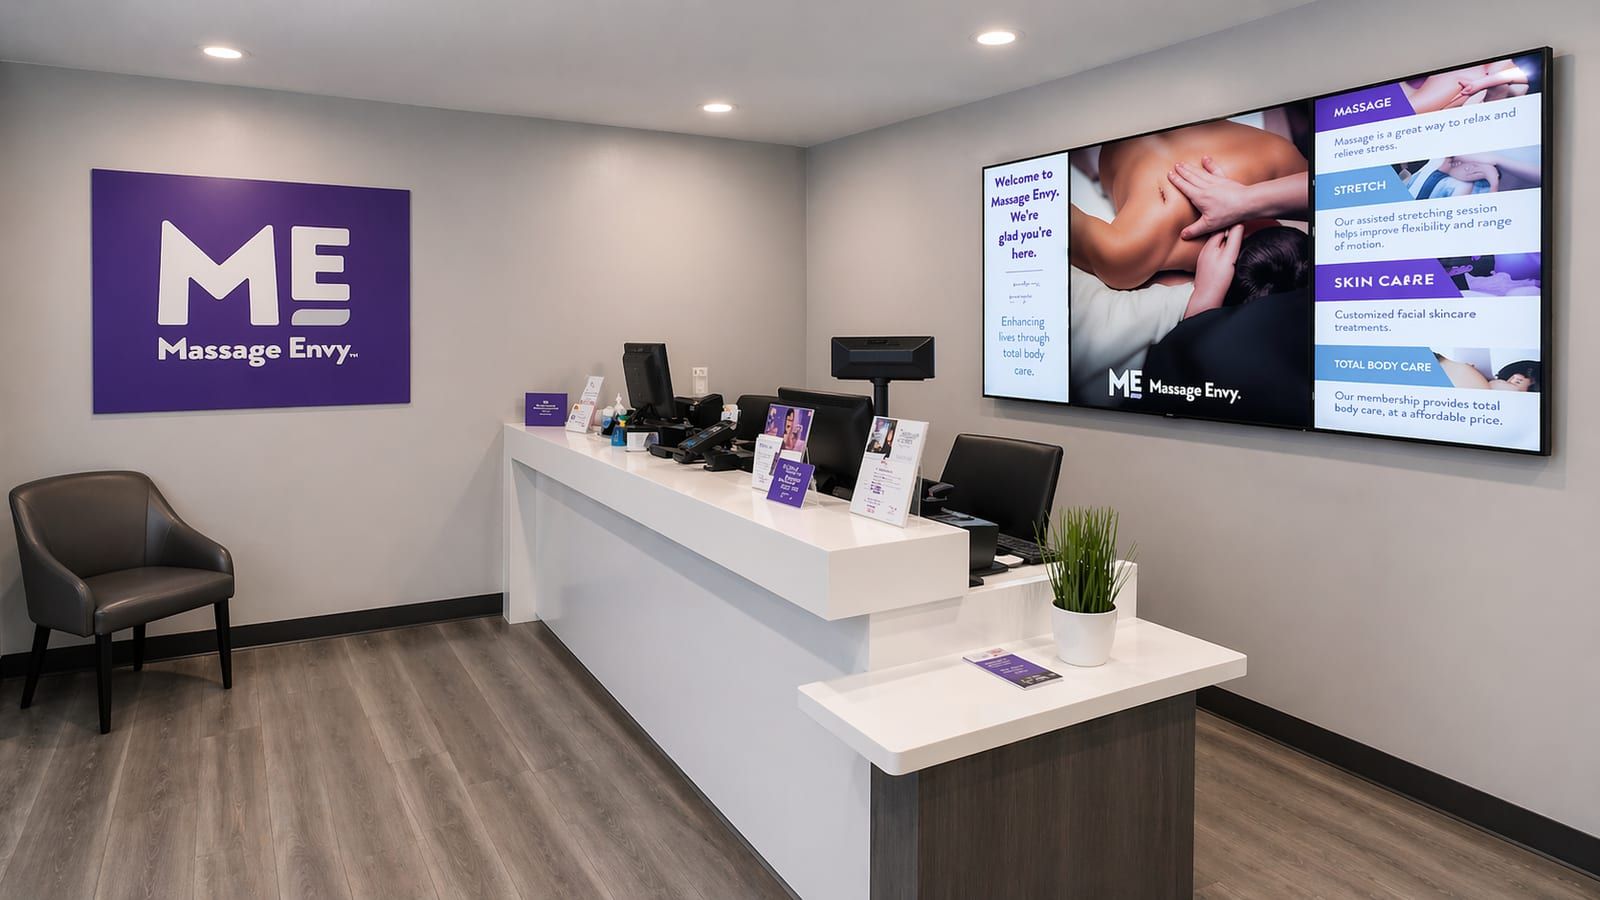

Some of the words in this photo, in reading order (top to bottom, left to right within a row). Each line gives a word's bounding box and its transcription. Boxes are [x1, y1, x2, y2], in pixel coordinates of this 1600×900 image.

[1334, 98, 1391, 117] MASSAGE
[1334, 133, 1374, 147] Massage
[1377, 131, 1384, 139] is
[1395, 125, 1421, 139] great
[1425, 122, 1445, 132] way
[1449, 119, 1460, 127] to
[1464, 113, 1491, 124] relax
[1494, 107, 1516, 120] and
[1334, 148, 1364, 158] relieve
[1366, 143, 1398, 153] stress.
[995, 173, 1039, 188] Welcome
[1042, 169, 1053, 179] to
[1334, 181, 1386, 195] STRETCH
[991, 193, 1030, 207] Massage
[1033, 188, 1060, 202] Envy.
[1010, 209, 1039, 223] We're
[1335, 217, 1353, 227] Our
[1357, 214, 1395, 225] assisted
[1398, 208, 1453, 221] stretching
[1456, 205, 1497, 215] session
[998, 231, 1018, 246] glad
[1021, 226, 1052, 244] you're
[1334, 229, 1358, 239] helps
[1360, 226, 1399, 237] improve
[1402, 220, 1450, 233] flexibility
[1453, 219, 1474, 230] and
[1478, 217, 1512, 230] range
[1012, 248, 1037, 259] here.
[1334, 242, 1345, 251] of
[1347, 240, 1384, 249] motion.
[158, 219, 350, 326] ME
[1335, 277, 1373, 288] SKIN
[1335, 310, 1394, 319] Customized
[1398, 309, 1426, 319] facial
[1429, 309, 1476, 318] skincare
[1001, 316, 1045, 330] Enhancing
[1335, 324, 1391, 332] treatments.
[998, 332, 1015, 342] lives
[1018, 333, 1050, 346] through
[158, 336, 281, 367] Massage
[1003, 349, 1021, 359] total
[1024, 350, 1045, 361] body
[1014, 367, 1034, 376] care.
[1334, 360, 1365, 369] TOTAL
[1367, 361, 1399, 370] BODY
[1401, 362, 1432, 372] CARE
[1109, 368, 1142, 398] ME
[1150, 379, 1201, 401] Massage
[1205, 382, 1241, 404] Envy.
[1335, 391, 1354, 401] Our
[1357, 393, 1420, 408] membership
[1423, 398, 1469, 410] provides
[1473, 400, 1500, 410] total
[1335, 404, 1358, 415] body
[1361, 408, 1385, 416] care,
[1388, 408, 1398, 417] at
[1410, 410, 1466, 422] affordable
[1470, 416, 1503, 426] price.
